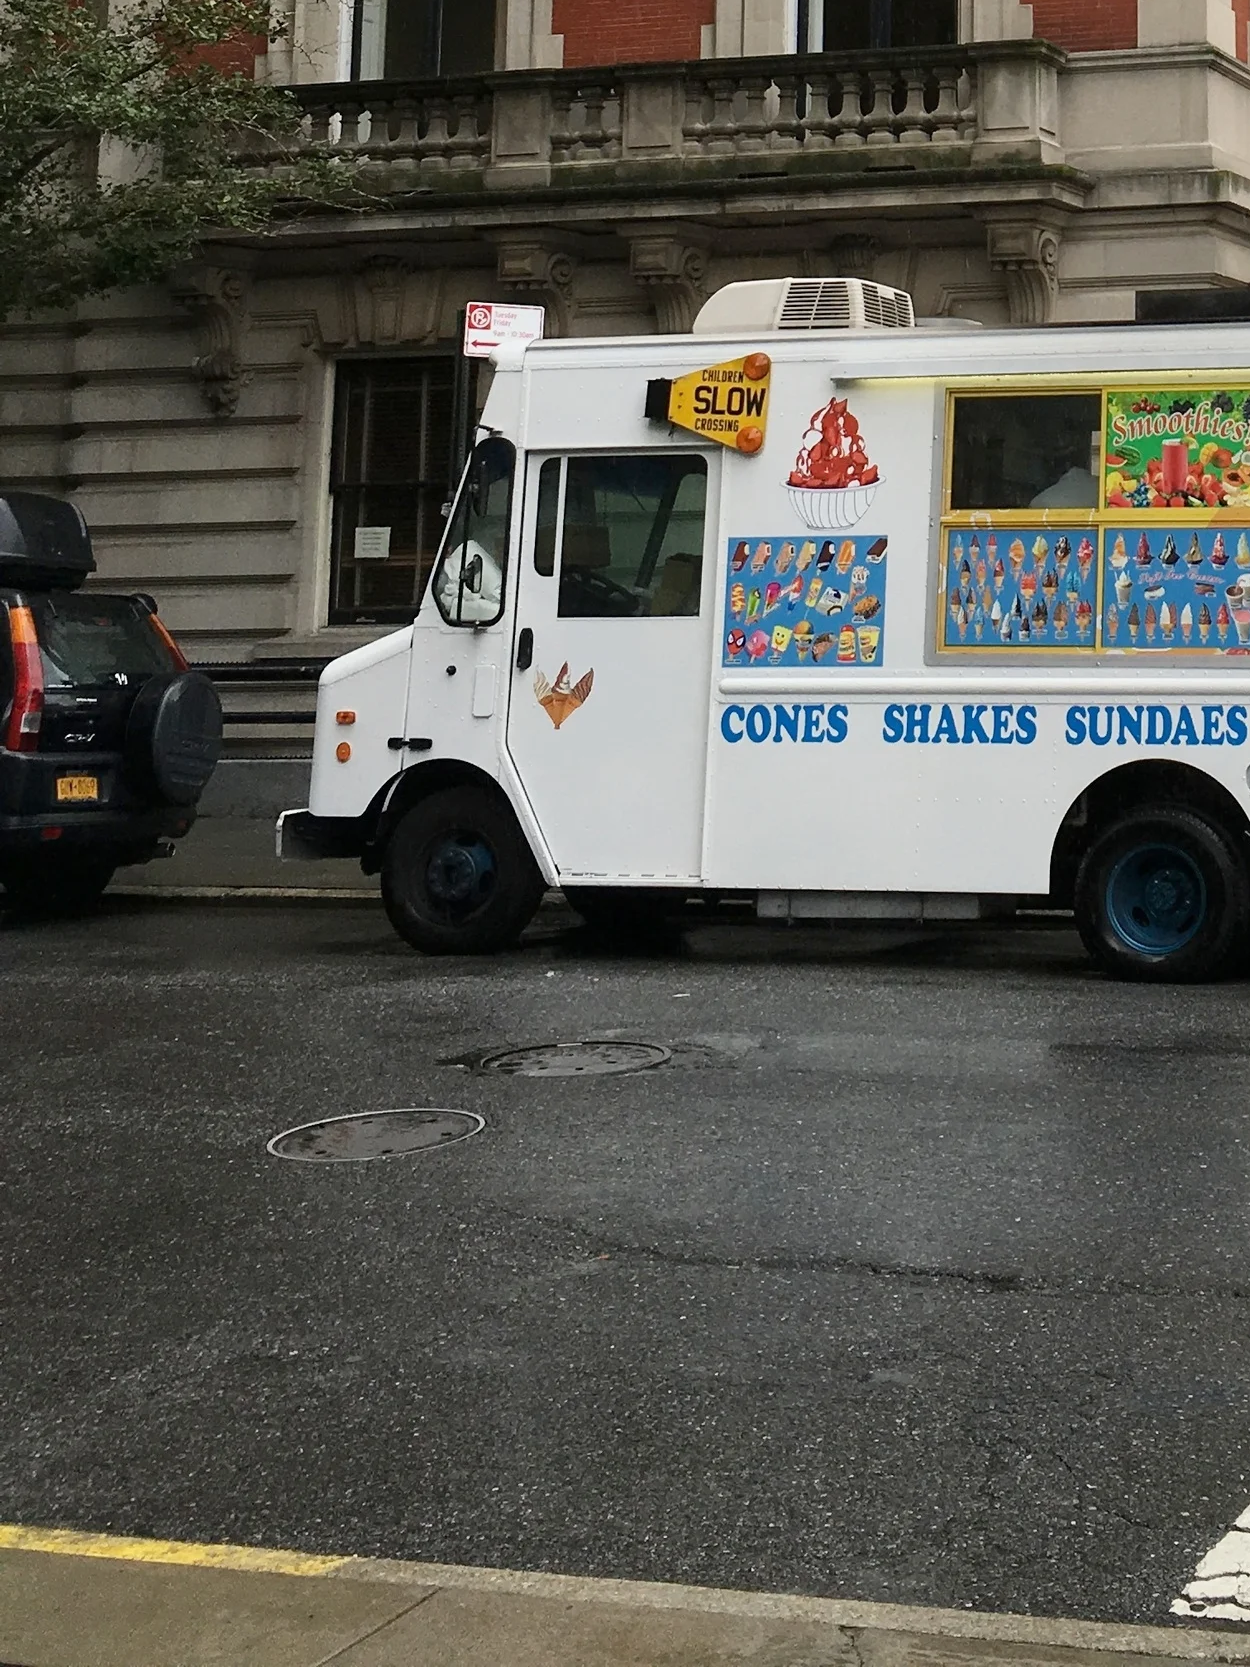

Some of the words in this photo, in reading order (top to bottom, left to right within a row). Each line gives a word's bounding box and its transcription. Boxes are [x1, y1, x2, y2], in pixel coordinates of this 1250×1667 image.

[494, 319, 511, 327] Friday
[702, 369, 744, 384] CHILDREN
[693, 385, 767, 417] SLOW
[694, 418, 740, 433] CROSSING
[720, 704, 848, 744] CONES
[883, 704, 1038, 745] SHAKES
[1065, 704, 1248, 746] SUNDAES
